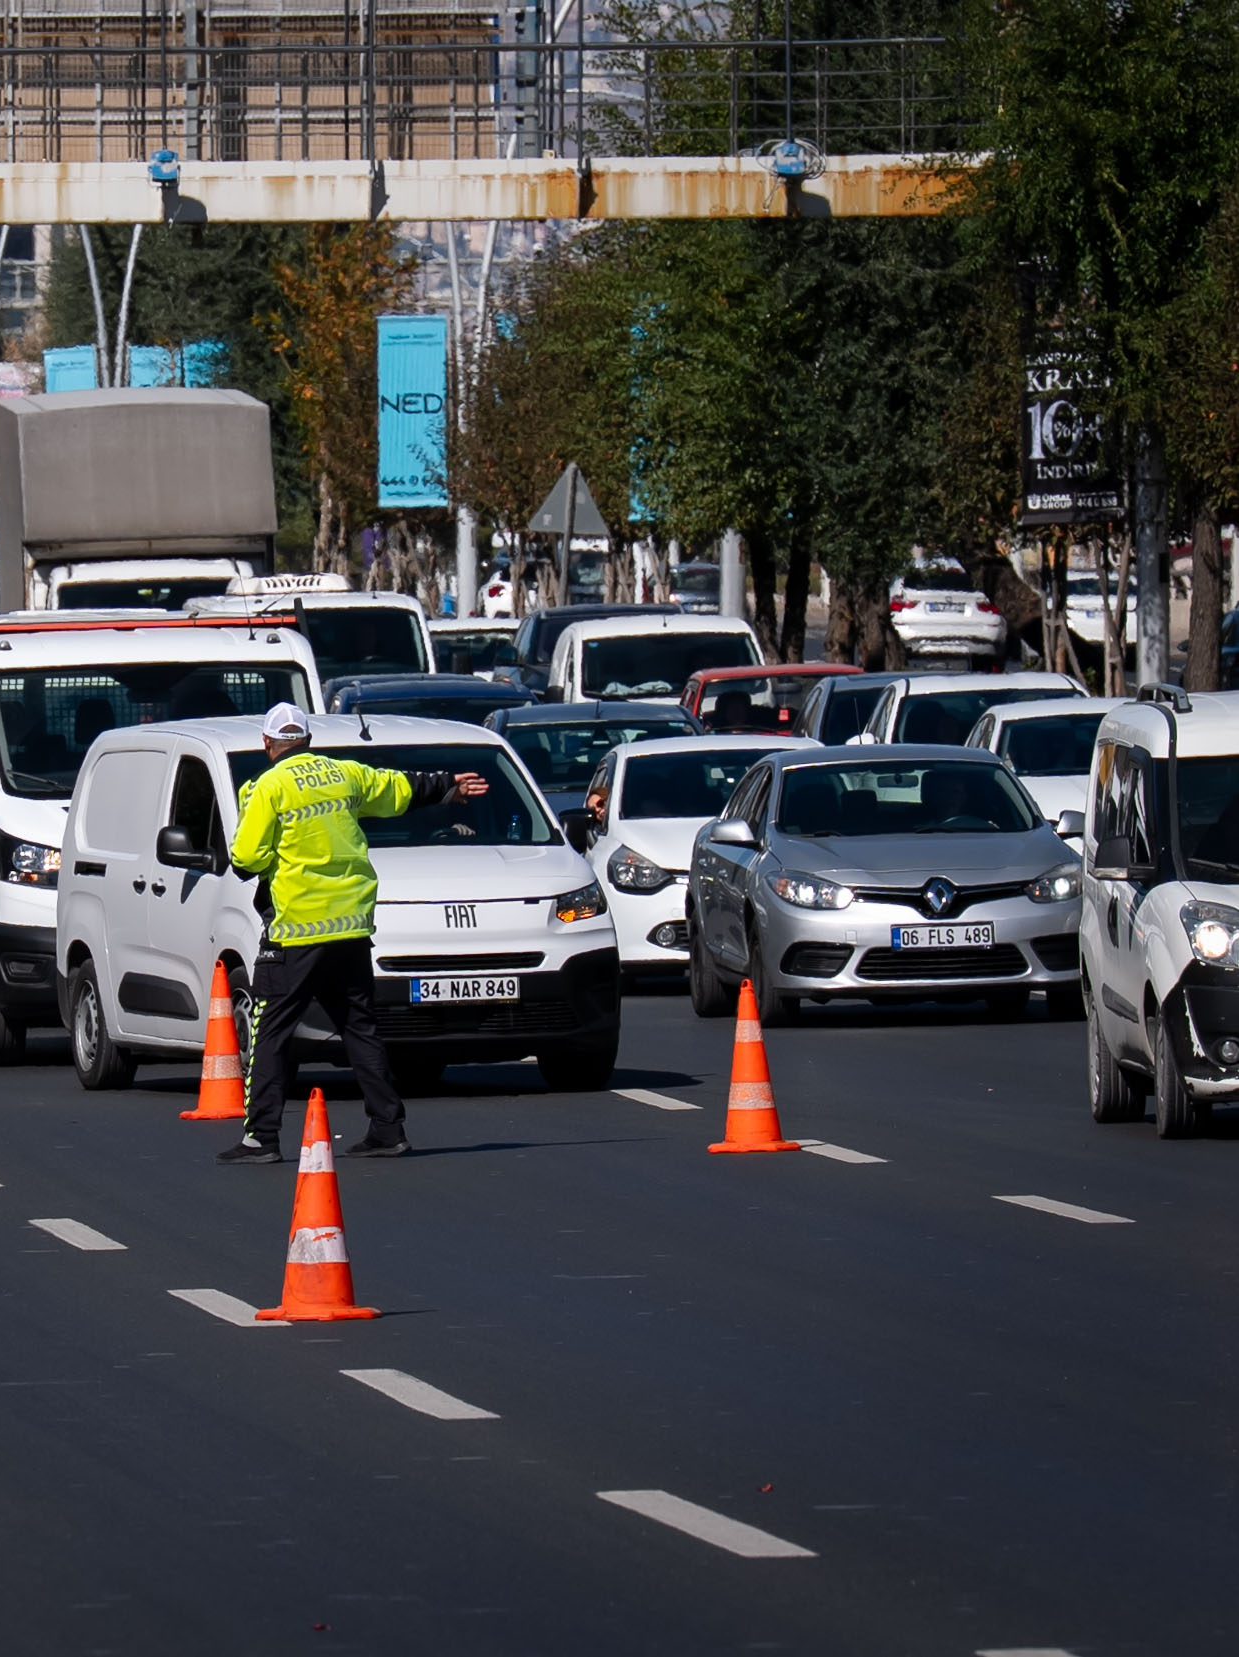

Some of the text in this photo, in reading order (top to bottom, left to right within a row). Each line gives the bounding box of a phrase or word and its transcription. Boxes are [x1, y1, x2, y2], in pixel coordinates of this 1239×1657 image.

[380, 393, 443, 415] NED
[294, 769, 345, 791] POLİSİ
[444, 904, 478, 929] FIAT
[902, 927, 991, 946] 06 FLS 489
[421, 979, 516, 999] 34 NAR 849
